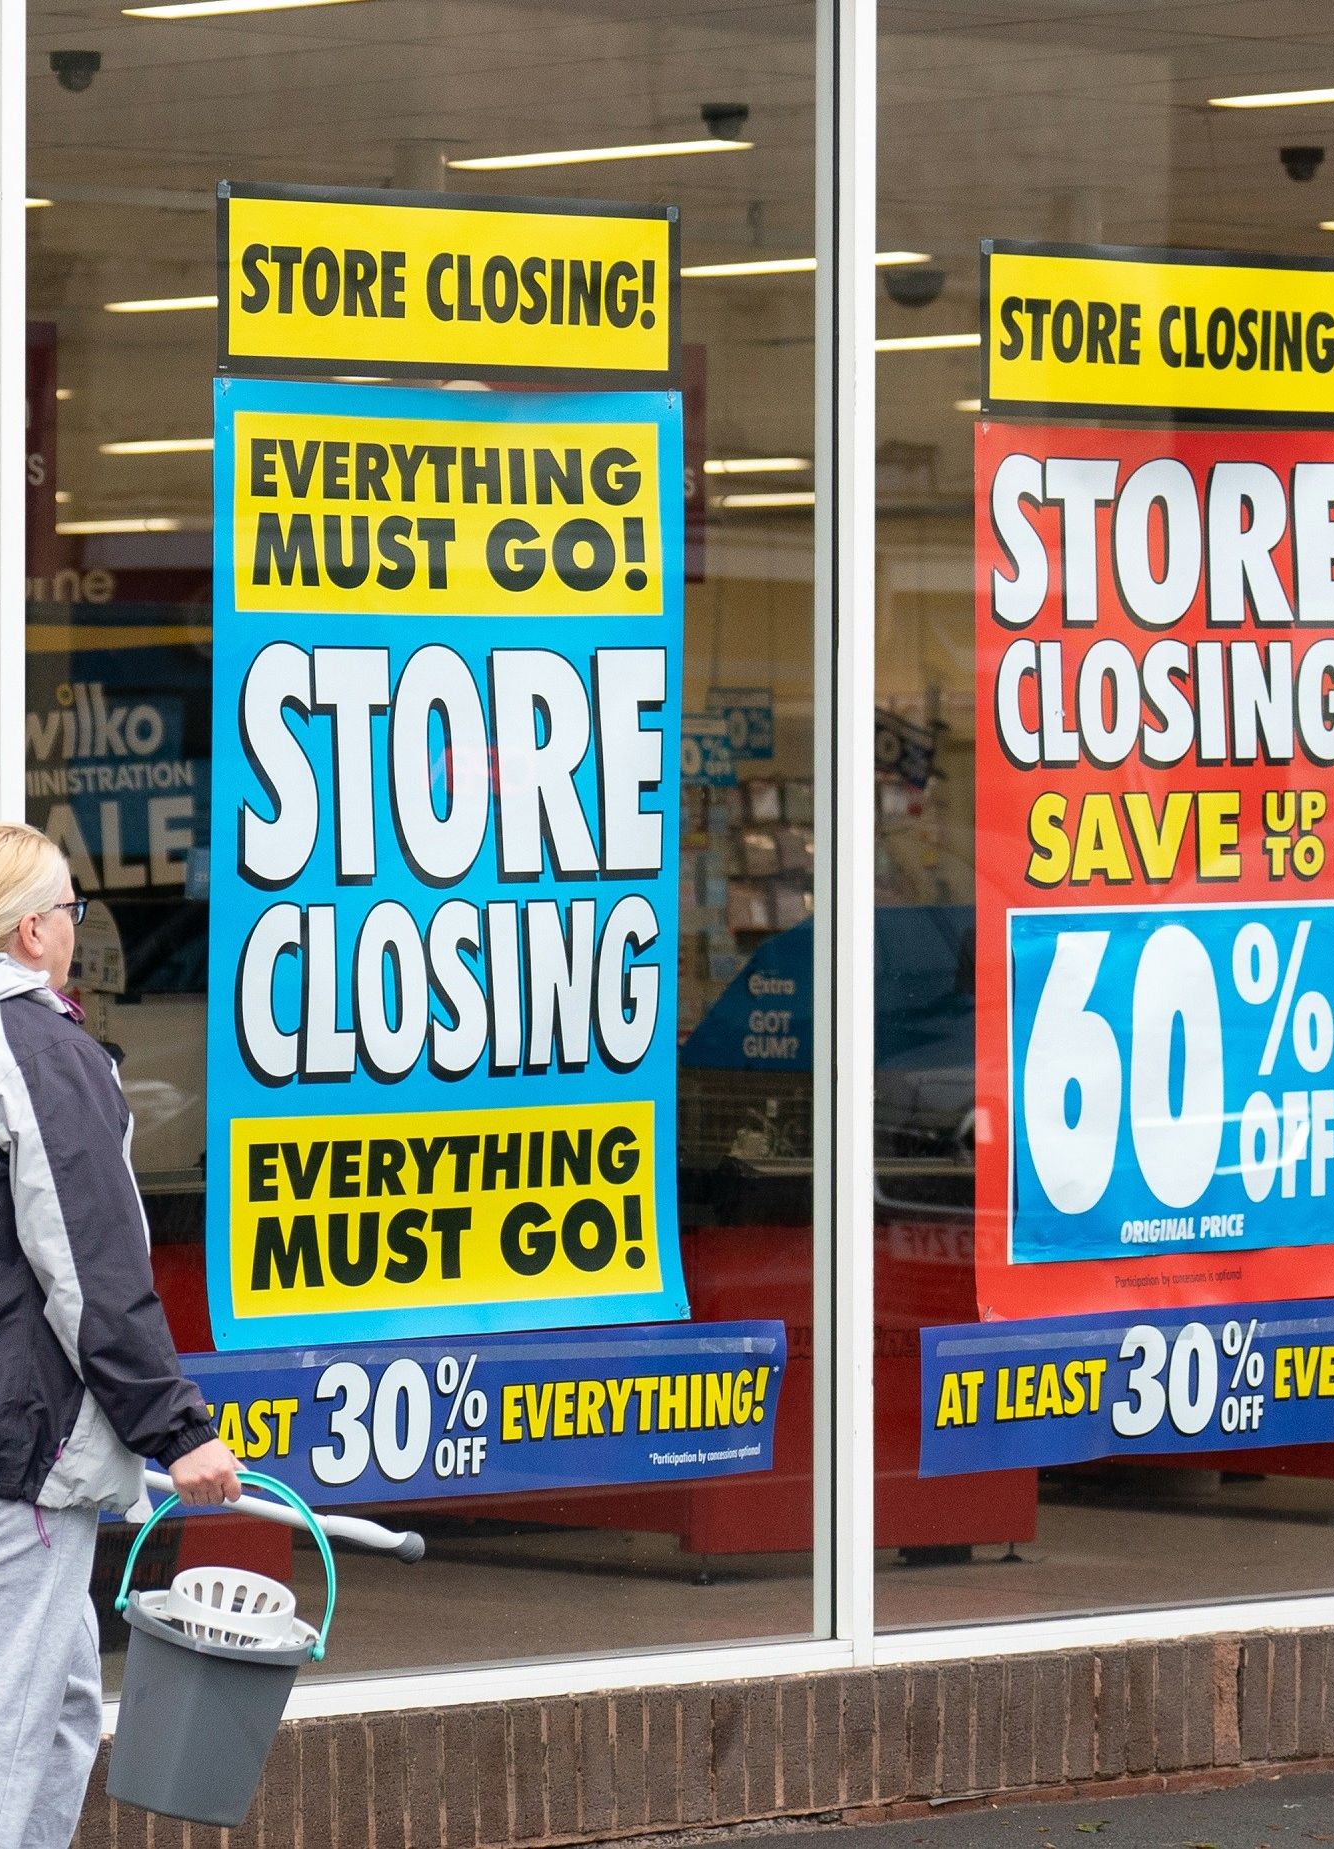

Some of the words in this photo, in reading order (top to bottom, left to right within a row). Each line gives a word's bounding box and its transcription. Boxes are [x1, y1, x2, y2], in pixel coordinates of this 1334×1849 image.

[241, 243, 406, 319] STORE
[426, 253, 656, 330] CLOSING!
[1000, 296, 1141, 365] STORE
[250, 437, 641, 505] EVERYTHING
[252, 512, 456, 591] MUST
[485, 517, 649, 593] GO!
[240, 643, 666, 885] STORE
[43, 796, 194, 893] ALE
[1026, 792, 1242, 885] SAVE
[1264, 791, 1327, 832] UP
[1264, 834, 1326, 878] TO
[237, 895, 661, 1082] CLOSING
[248, 1126, 641, 1203] EVERYTHING
[1240, 1090, 1334, 1203] OFF
[250, 1207, 472, 1291] MUST
[500, 1194, 646, 1276] GO!
[1120, 1217, 1196, 1244] ORIGINAL
[1200, 1213, 1244, 1239] PRICE
[1114, 1273, 1160, 1289] Participation
[1161, 1272, 1170, 1287] by
[1214, 1268, 1243, 1282] optional
[936, 1371, 985, 1428] AT
[996, 1360, 1108, 1421] LEAST
[1221, 1394, 1264, 1432] OFF
[206, 1398, 300, 1462] AST
[435, 1436, 487, 1477] OFF
[698, 1449, 707, 1464] by
